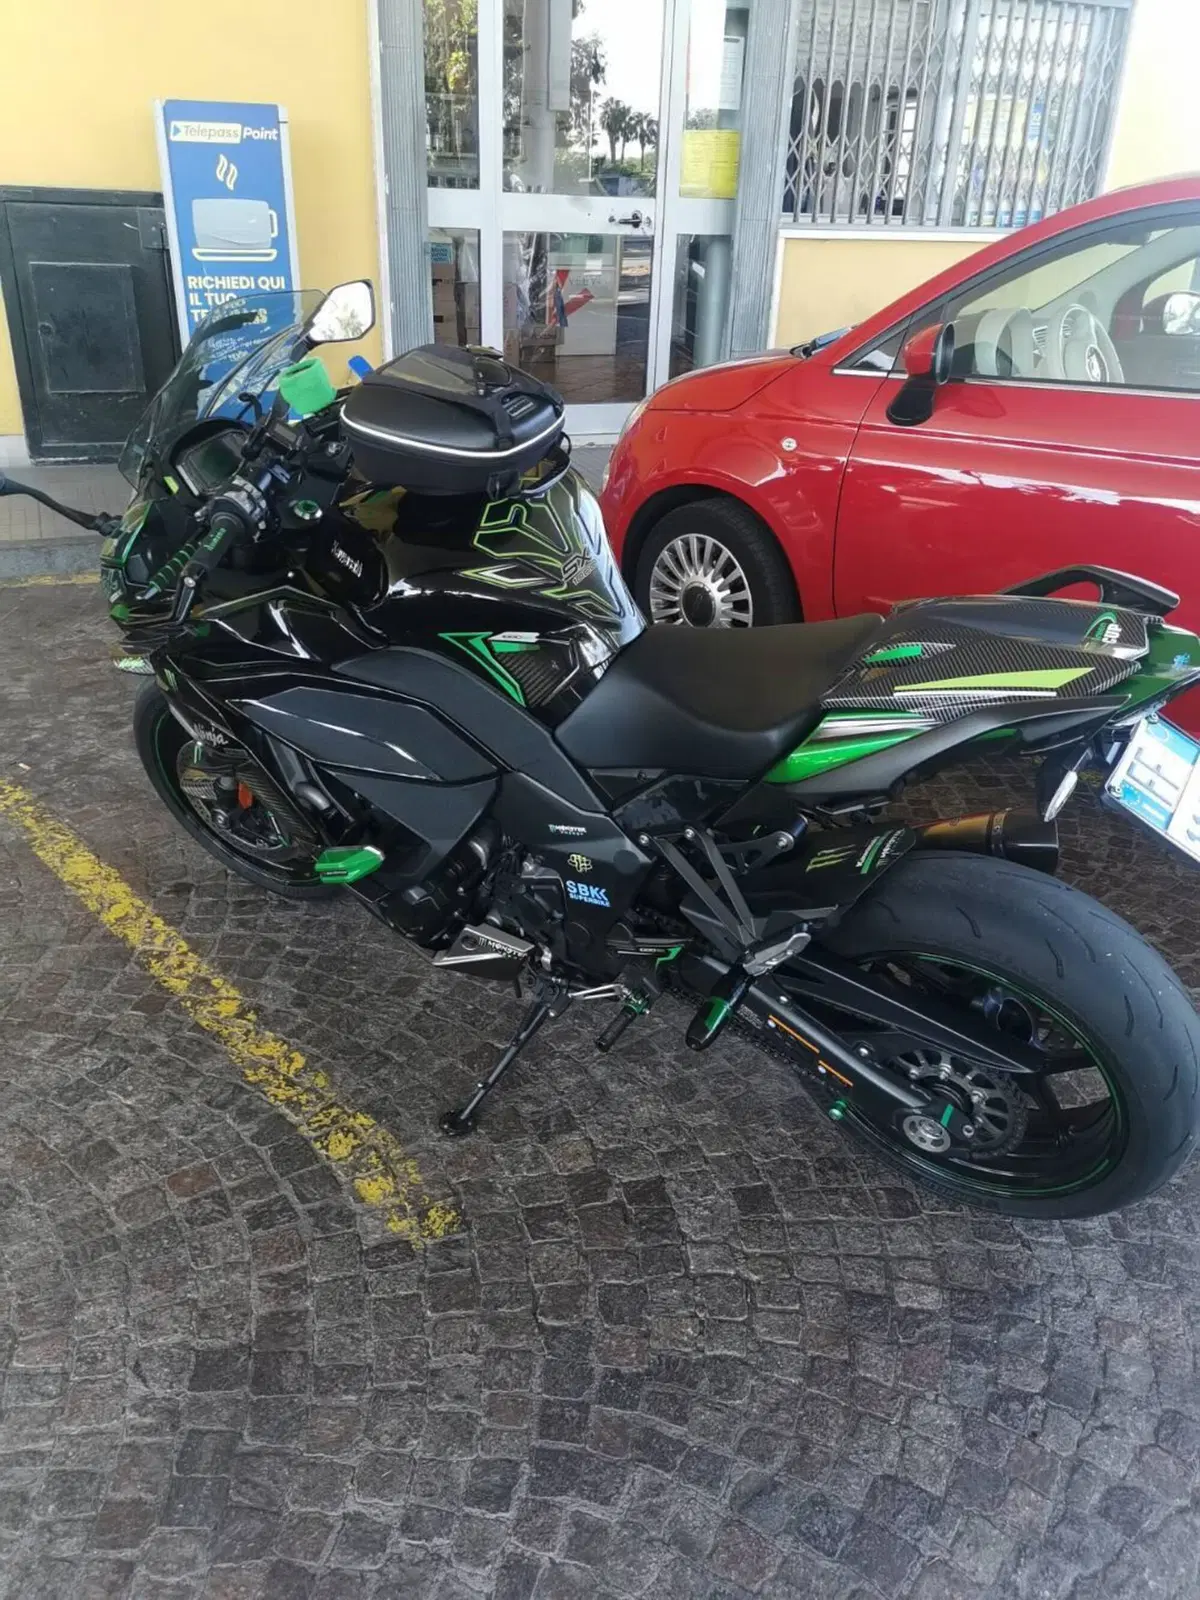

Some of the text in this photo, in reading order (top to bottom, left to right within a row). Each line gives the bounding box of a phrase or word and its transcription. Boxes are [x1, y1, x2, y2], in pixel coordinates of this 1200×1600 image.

[183, 124, 278, 140] Telepass Point
[187, 276, 285, 291] RICHIEDI QUI
[189, 293, 202, 306] IL
[1102, 623, 1122, 644] CUP
